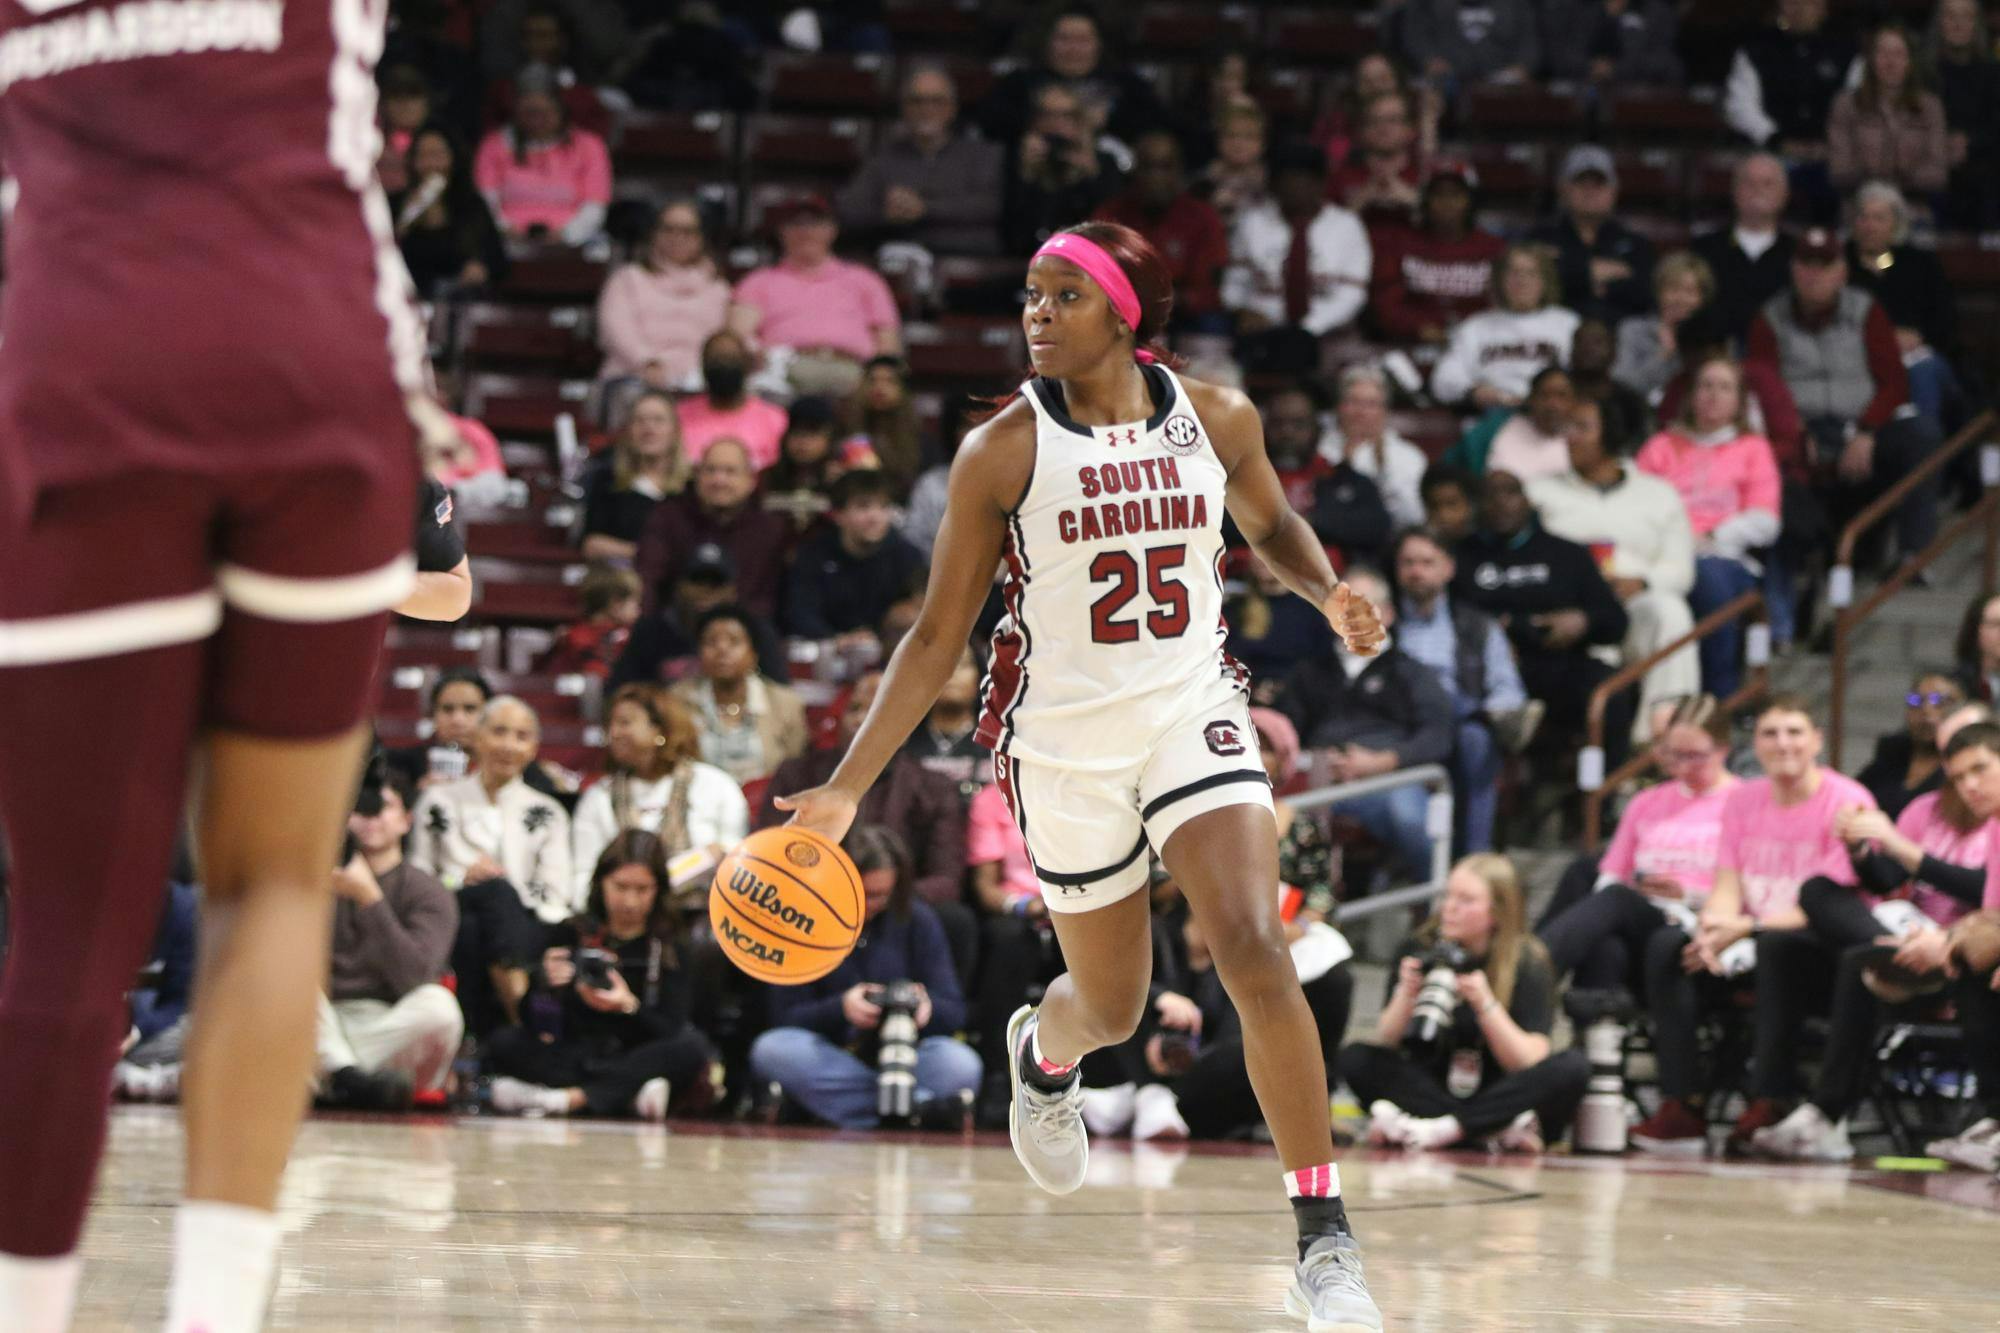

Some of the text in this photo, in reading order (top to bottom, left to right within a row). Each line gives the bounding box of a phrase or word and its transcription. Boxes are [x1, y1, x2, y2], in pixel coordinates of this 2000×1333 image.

[1166, 416, 1197, 446] SEC
[1078, 457, 1183, 499] SOUTH
[1058, 494, 1208, 545] CAROLINA
[1089, 543, 1191, 645] 25
[729, 867, 815, 935] Wilson
[720, 916, 786, 967] NCAA
